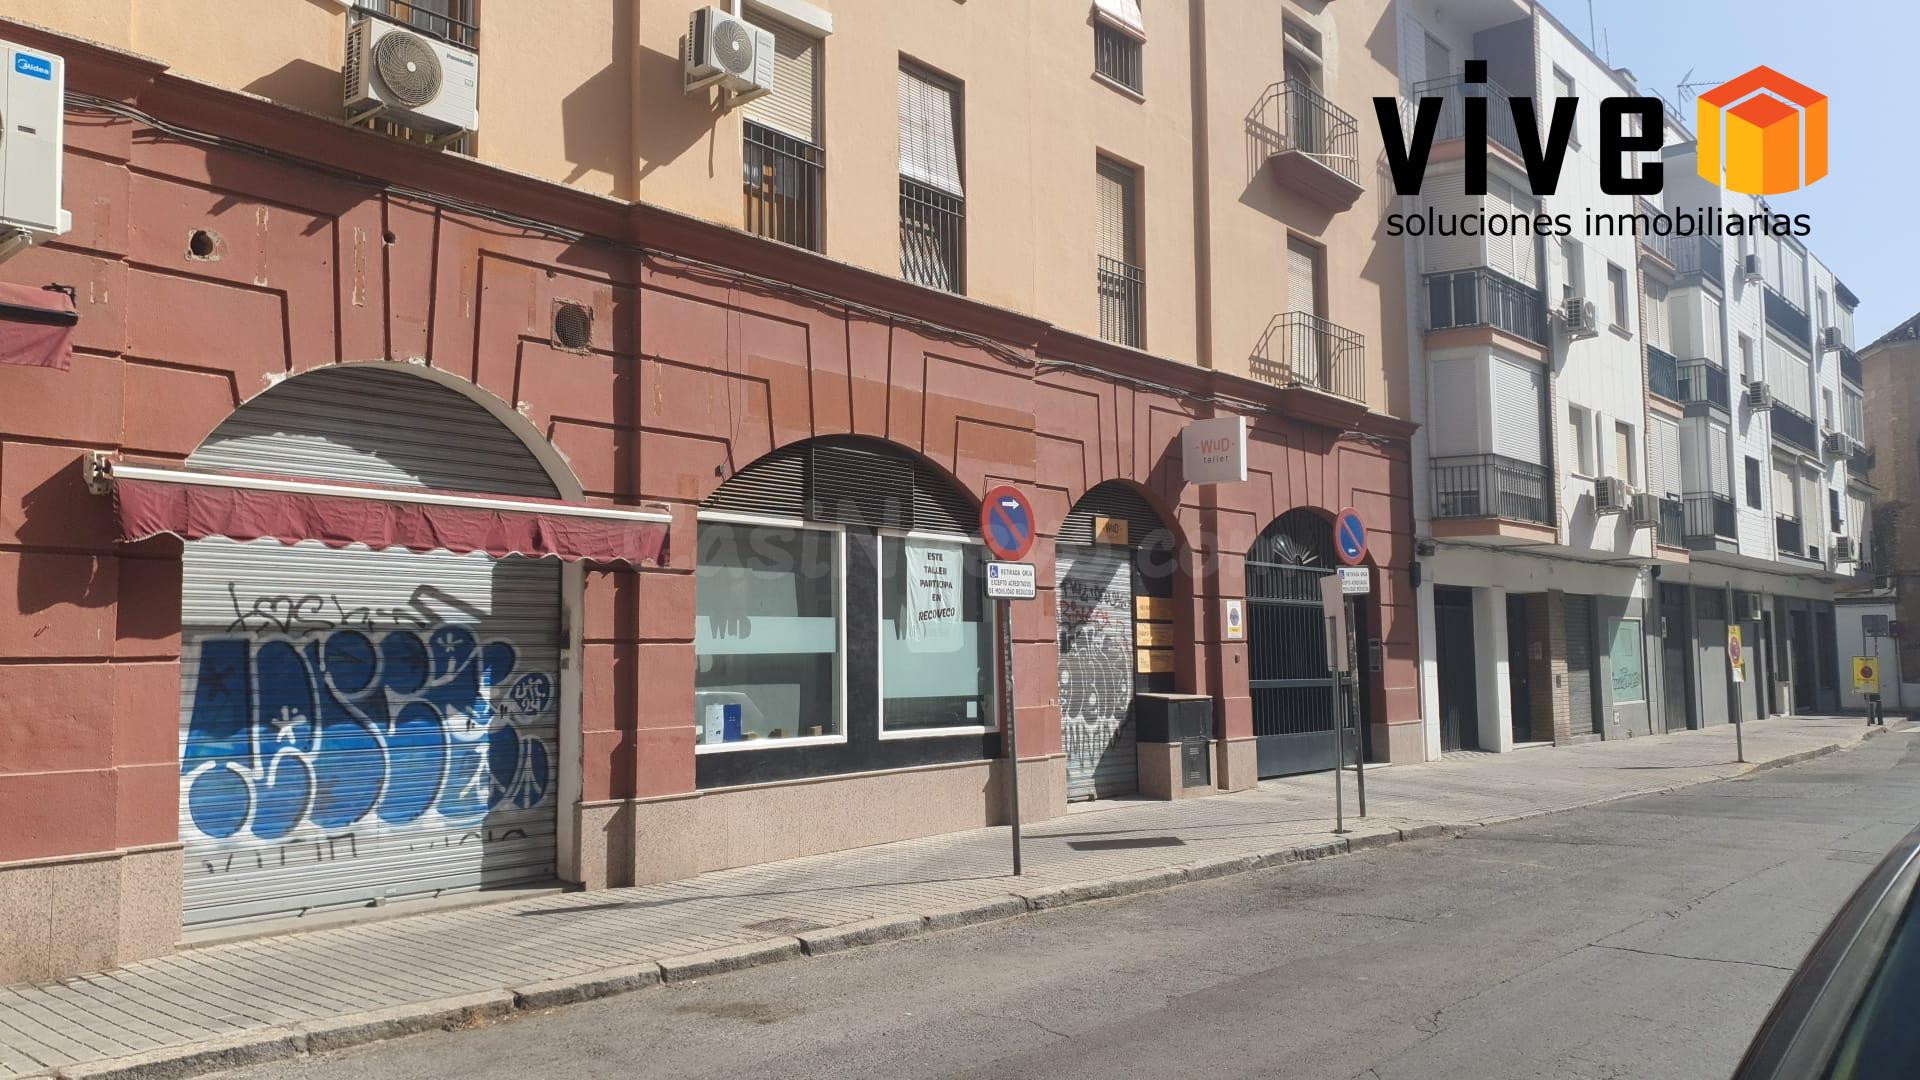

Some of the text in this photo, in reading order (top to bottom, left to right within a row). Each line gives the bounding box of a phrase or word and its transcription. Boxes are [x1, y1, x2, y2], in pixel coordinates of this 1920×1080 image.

[22, 62, 49, 75] Midea
[927, 552, 943, 562] ESTE
[924, 565, 947, 575] TALLER
[919, 579, 953, 589] PARTICIPA
[991, 579, 1007, 587] EXCEPTO
[932, 593, 942, 602] EN
[918, 607, 955, 621] RECOVECO
